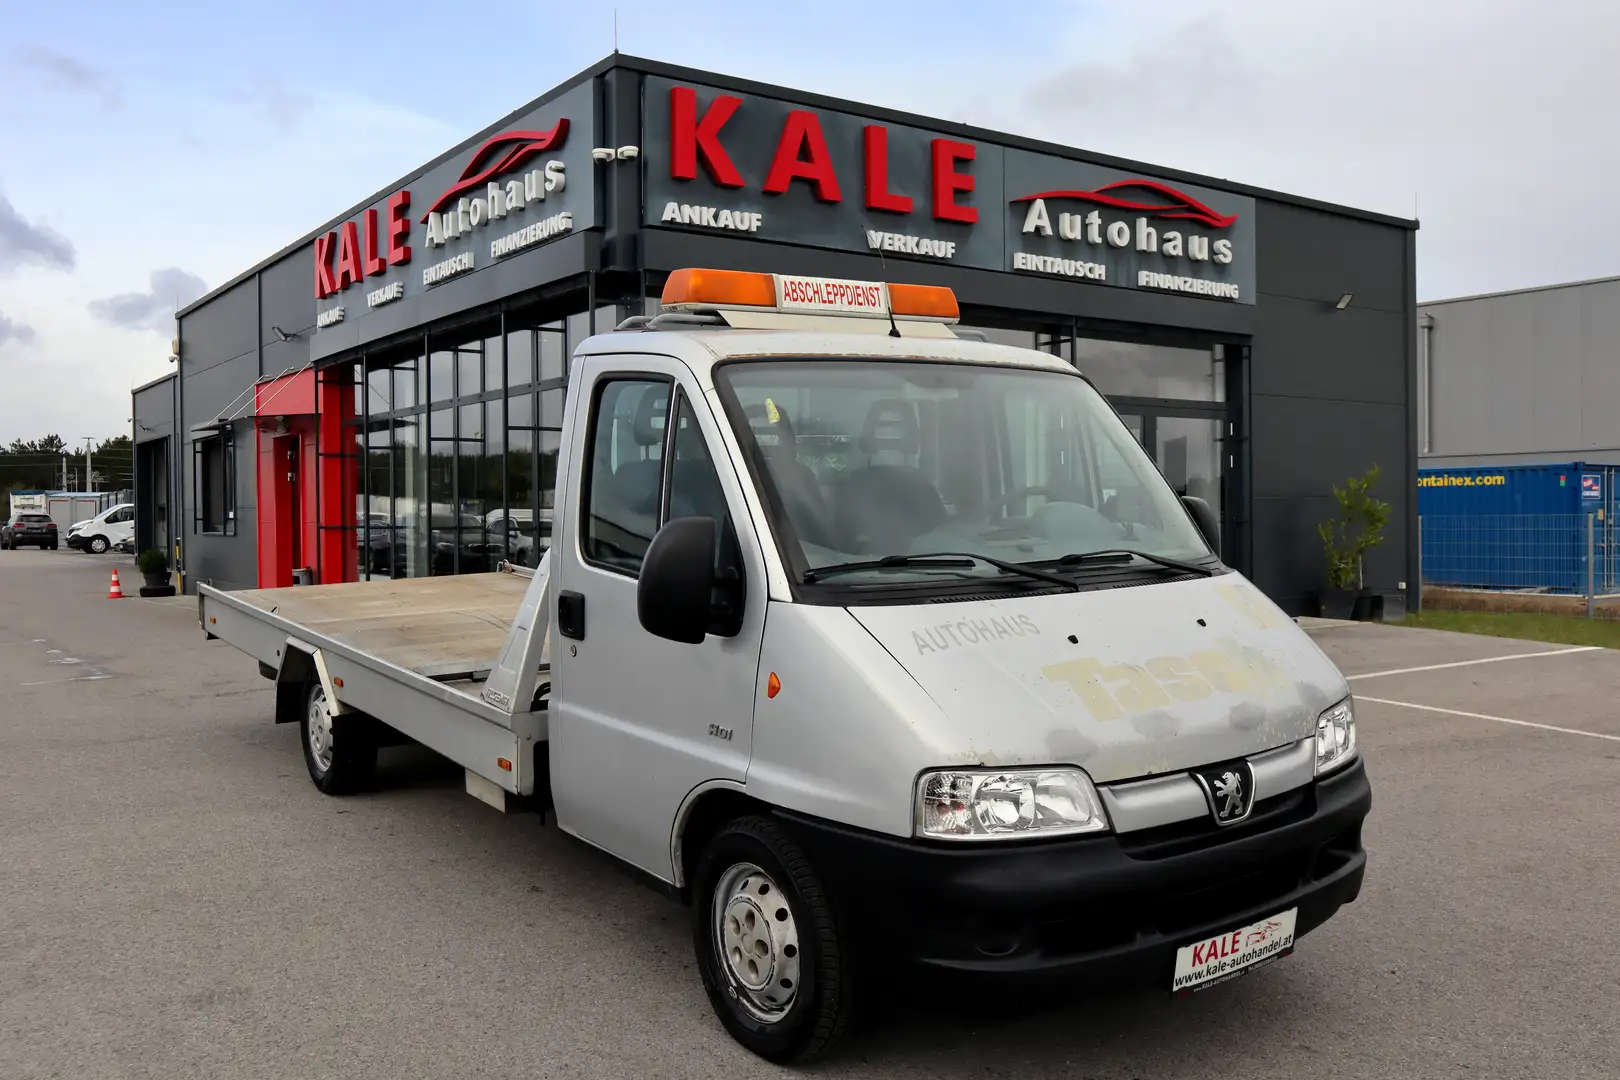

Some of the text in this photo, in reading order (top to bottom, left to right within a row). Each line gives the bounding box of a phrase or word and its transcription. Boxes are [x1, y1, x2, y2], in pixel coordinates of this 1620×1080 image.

[669, 85, 979, 224] KALE
[425, 159, 566, 248] Autohaus
[661, 201, 762, 232] ANKAUF
[314, 190, 412, 299] KALE
[490, 211, 573, 259] FINANZIERUNG
[866, 229, 956, 259] VERKAUF
[1022, 198, 1233, 265] Autohaus
[423, 252, 475, 285] EINTAUSCH
[1013, 252, 1106, 281] EINTAUSCH
[367, 281, 404, 307] VERKAUF
[783, 280, 882, 308] ABSCHLEPPDIENST
[1137, 270, 1239, 299] FINANZIERUNG
[317, 306, 345, 328] ANKAUF
[912, 614, 1041, 656] AUTOHAUS
[1174, 934, 1293, 987] www.kale-autohandel.at
[1191, 931, 1242, 968] KALE
